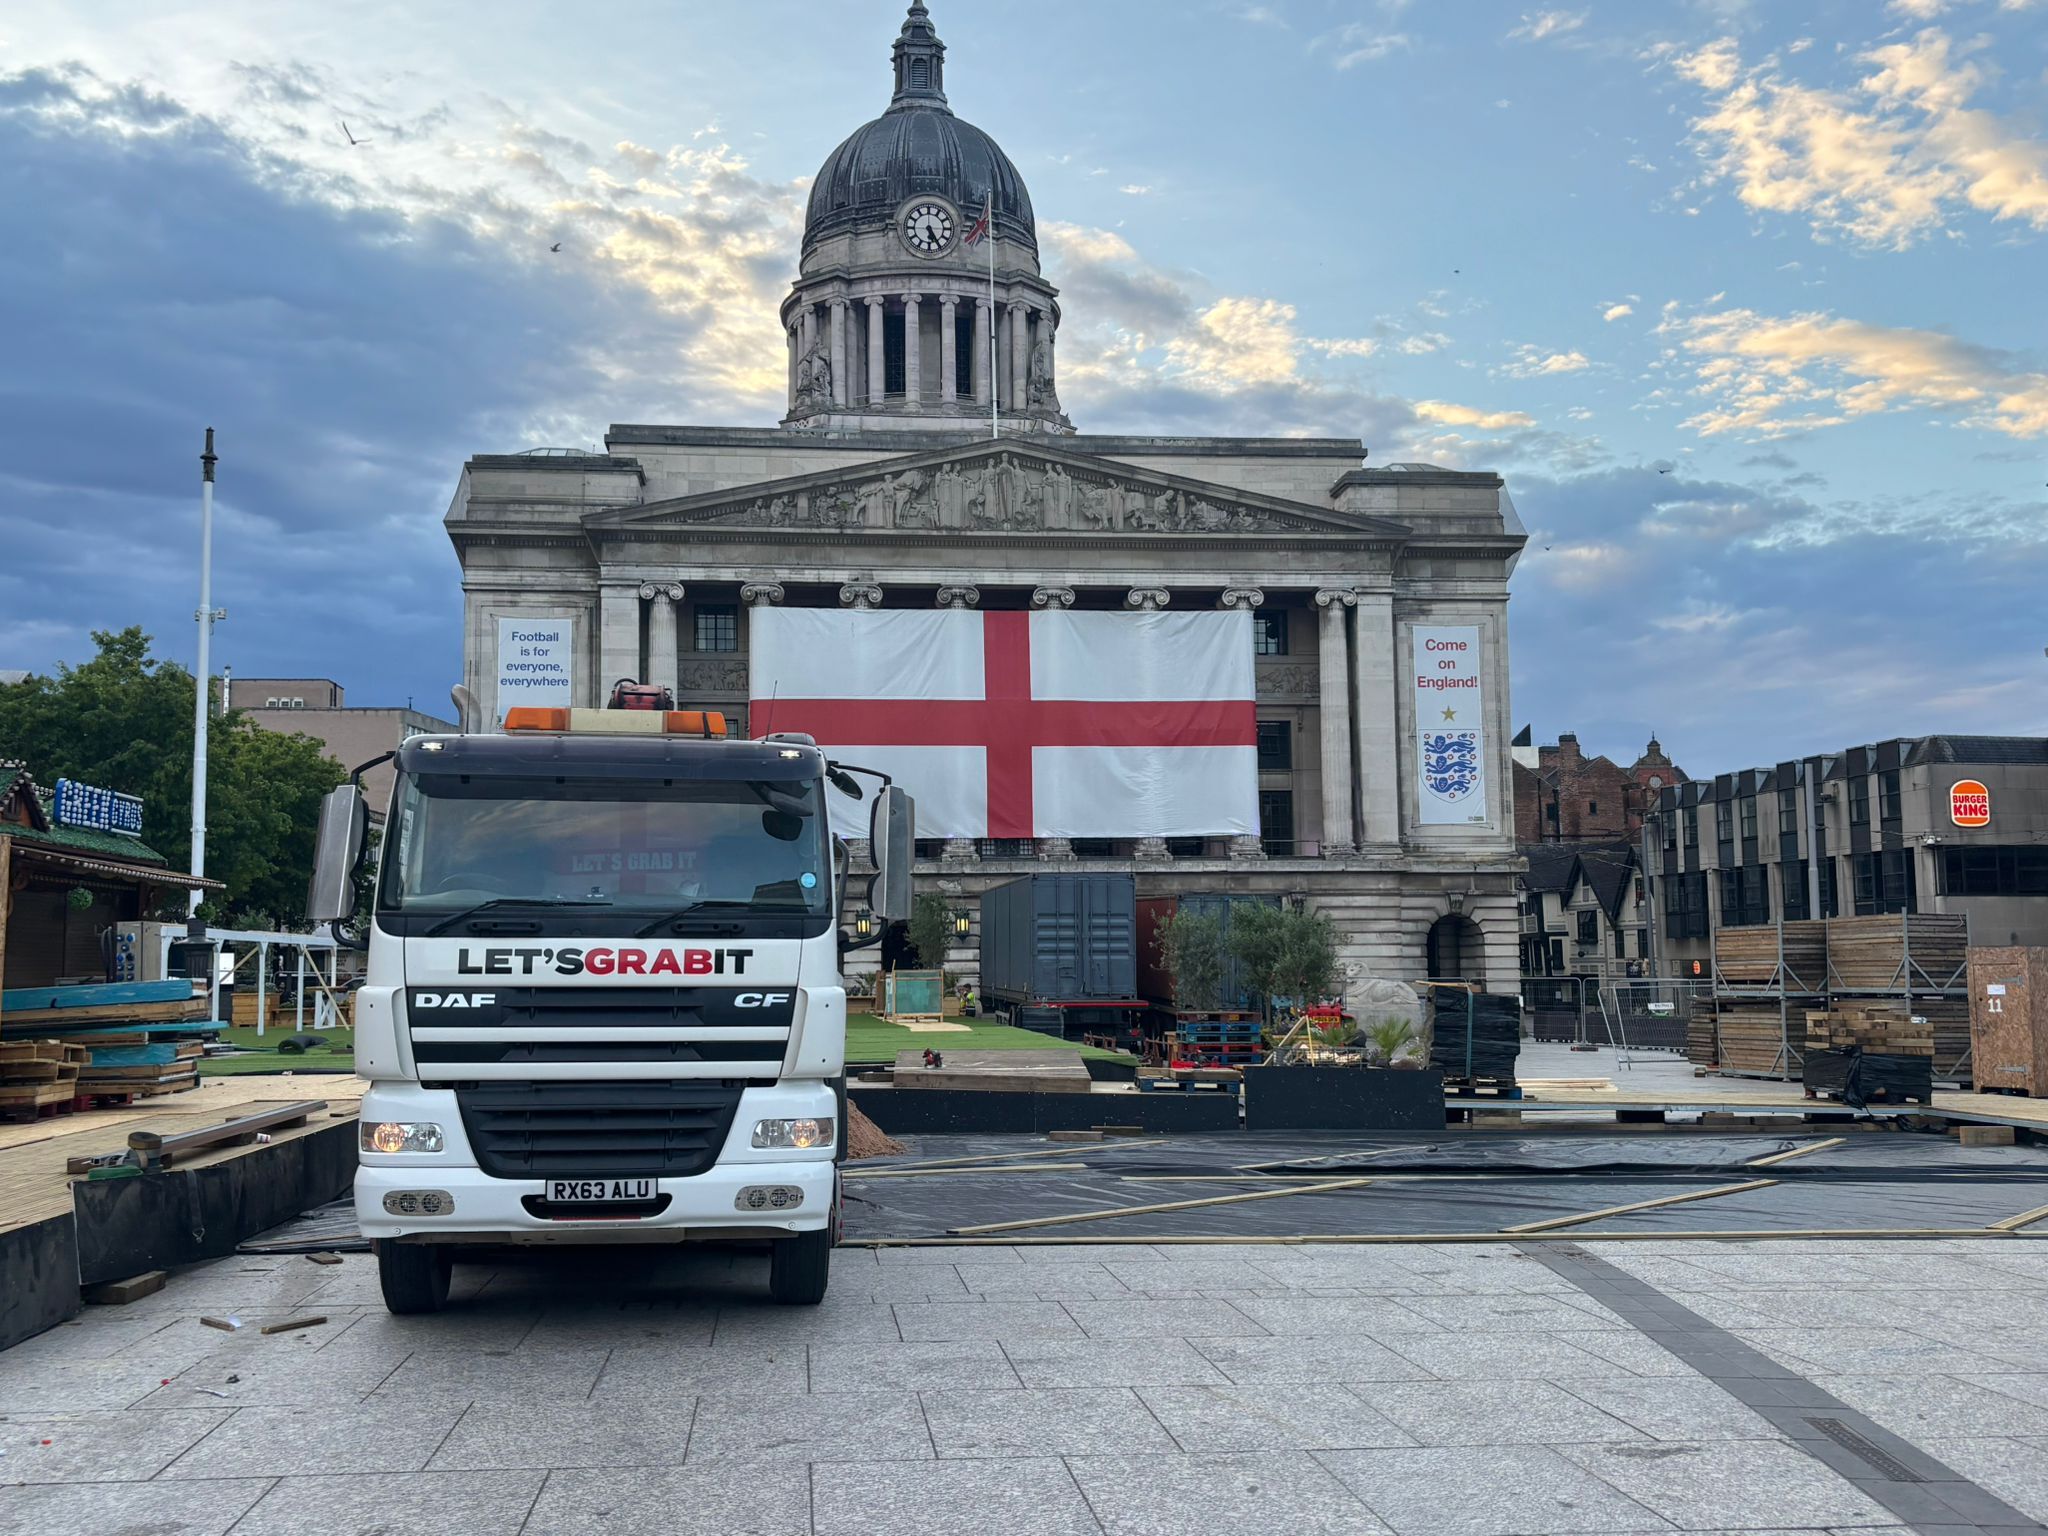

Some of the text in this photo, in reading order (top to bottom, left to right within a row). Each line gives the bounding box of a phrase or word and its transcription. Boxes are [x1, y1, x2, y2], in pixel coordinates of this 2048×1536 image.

[511, 631, 559, 642] Football
[520, 646, 550, 656] is for
[1425, 638, 1467, 651] Come
[506, 663, 563, 673] everyone,
[1438, 660, 1456, 669] on
[500, 676, 569, 688] everywhere
[1417, 676, 1478, 691] England!
[1952, 794, 1987, 803] BURGER
[111, 798, 143, 831] GYROS
[1953, 804, 1988, 816] KING
[572, 851, 697, 872] LET'S GRAB IT
[415, 993, 496, 1008] DAF
[733, 993, 790, 1008] CF
[1987, 998, 2003, 1013] 11
[554, 1180, 649, 1199] RX63 ALU
